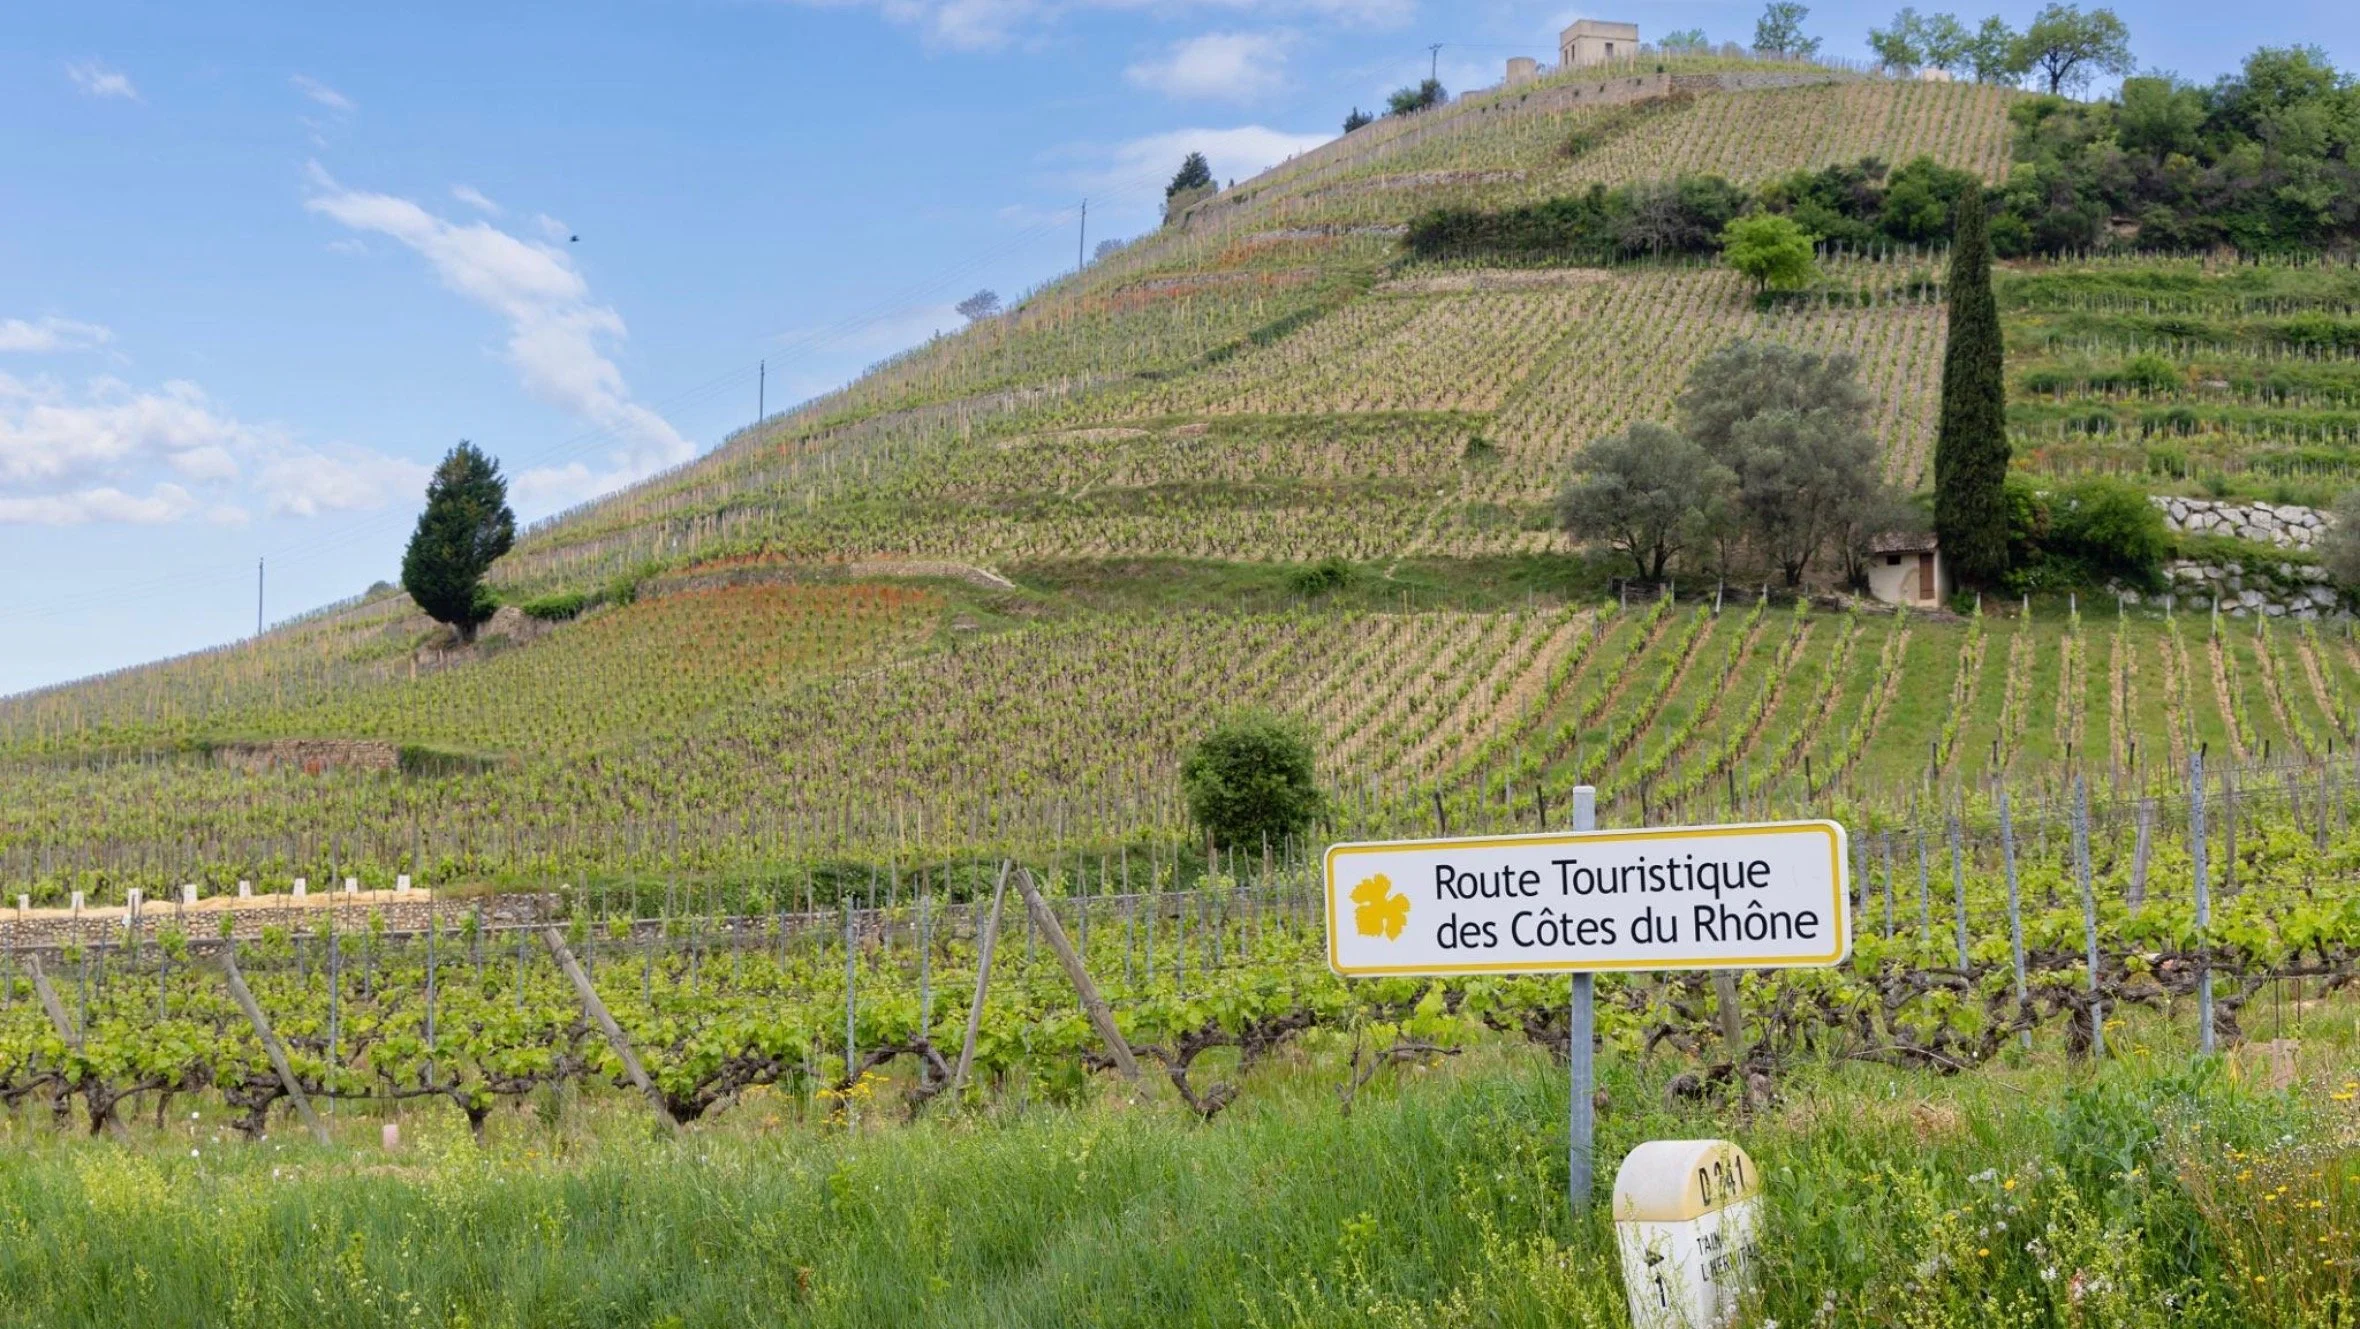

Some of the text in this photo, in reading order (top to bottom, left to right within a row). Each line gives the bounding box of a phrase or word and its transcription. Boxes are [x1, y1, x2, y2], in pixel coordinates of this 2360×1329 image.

[1435, 853, 1771, 900] Route Touristique
[1436, 899, 1819, 949] des Côtes du Rhône
[1698, 1167, 1711, 1207] D
